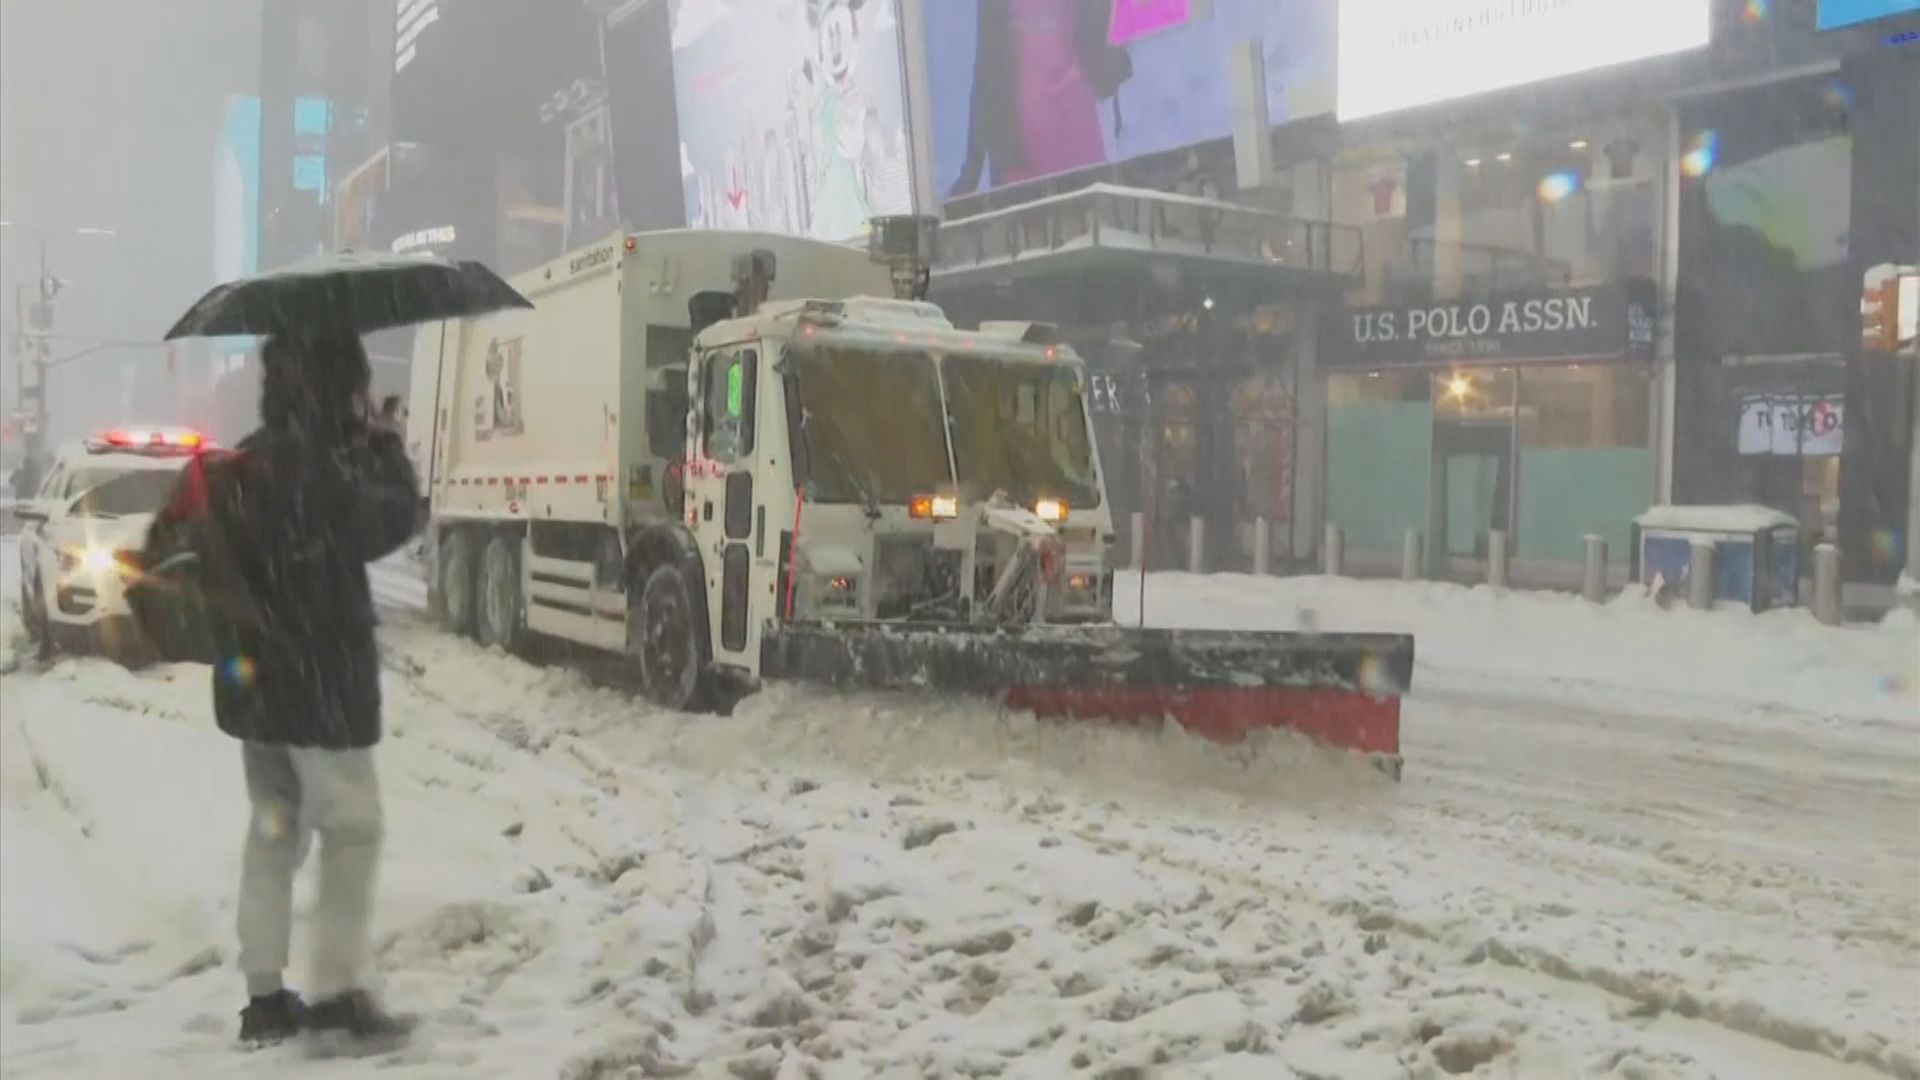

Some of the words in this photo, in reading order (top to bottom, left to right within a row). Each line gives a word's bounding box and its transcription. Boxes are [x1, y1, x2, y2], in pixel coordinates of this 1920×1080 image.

[1353, 312, 1400, 343] U.S.
[1407, 305, 1491, 340] POLO
[1497, 296, 1598, 334] ASSN.
